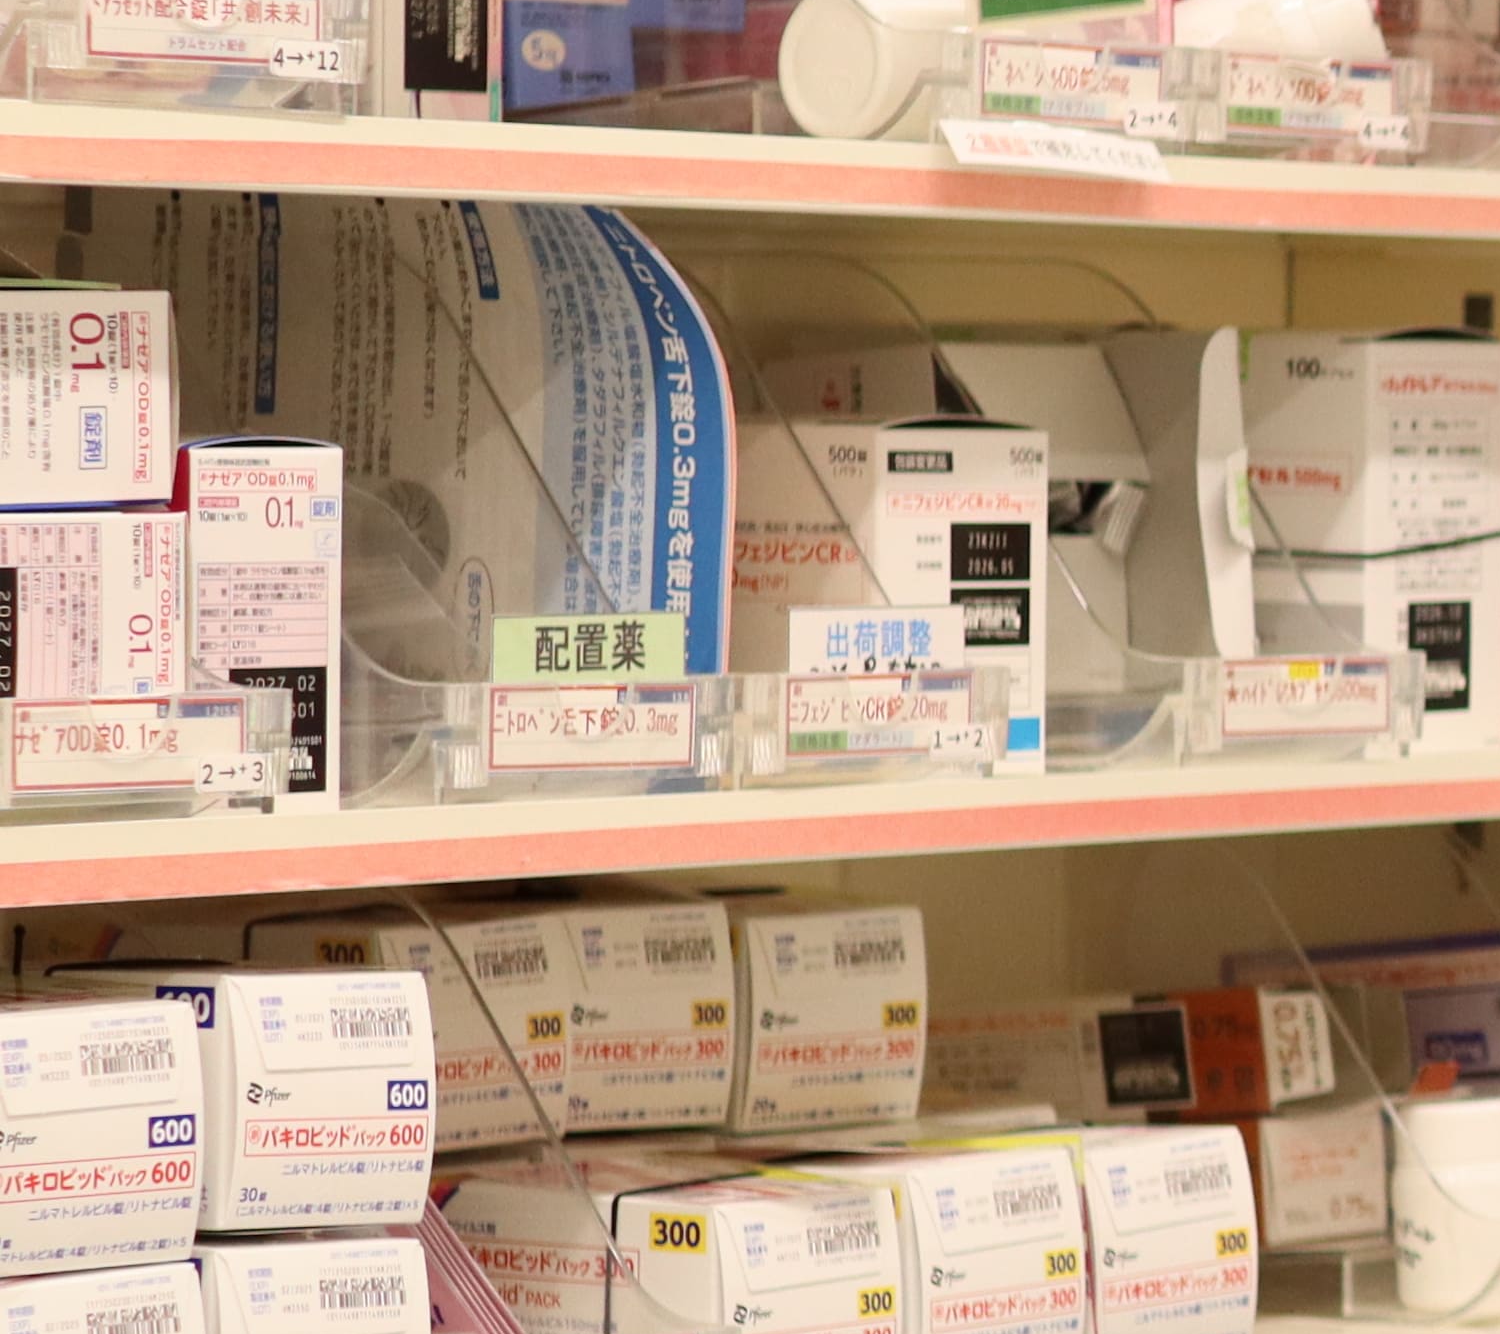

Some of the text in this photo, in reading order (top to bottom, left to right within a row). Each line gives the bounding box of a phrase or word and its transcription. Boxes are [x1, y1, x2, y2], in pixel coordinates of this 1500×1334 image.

[83, 411, 103, 463] 錠剤
[534, 620, 646, 674] 配置薬
[827, 617, 932, 659] 出荷調整
[528, 1014, 563, 1039] 300
[694, 1003, 727, 1028] 300
[884, 1004, 917, 1028] 300
[389, 1083, 427, 1109] 600
[151, 1117, 194, 1144] 600
[388, 1123, 425, 1146] 600
[150, 1160, 192, 1184] 600
[652, 1219, 702, 1249] 300
[1216, 1231, 1248, 1254] 300
[1045, 1252, 1078, 1276] 300
[1219, 1266, 1249, 1291] 300
[860, 1290, 894, 1314] 300
[1047, 1287, 1079, 1311] 300
